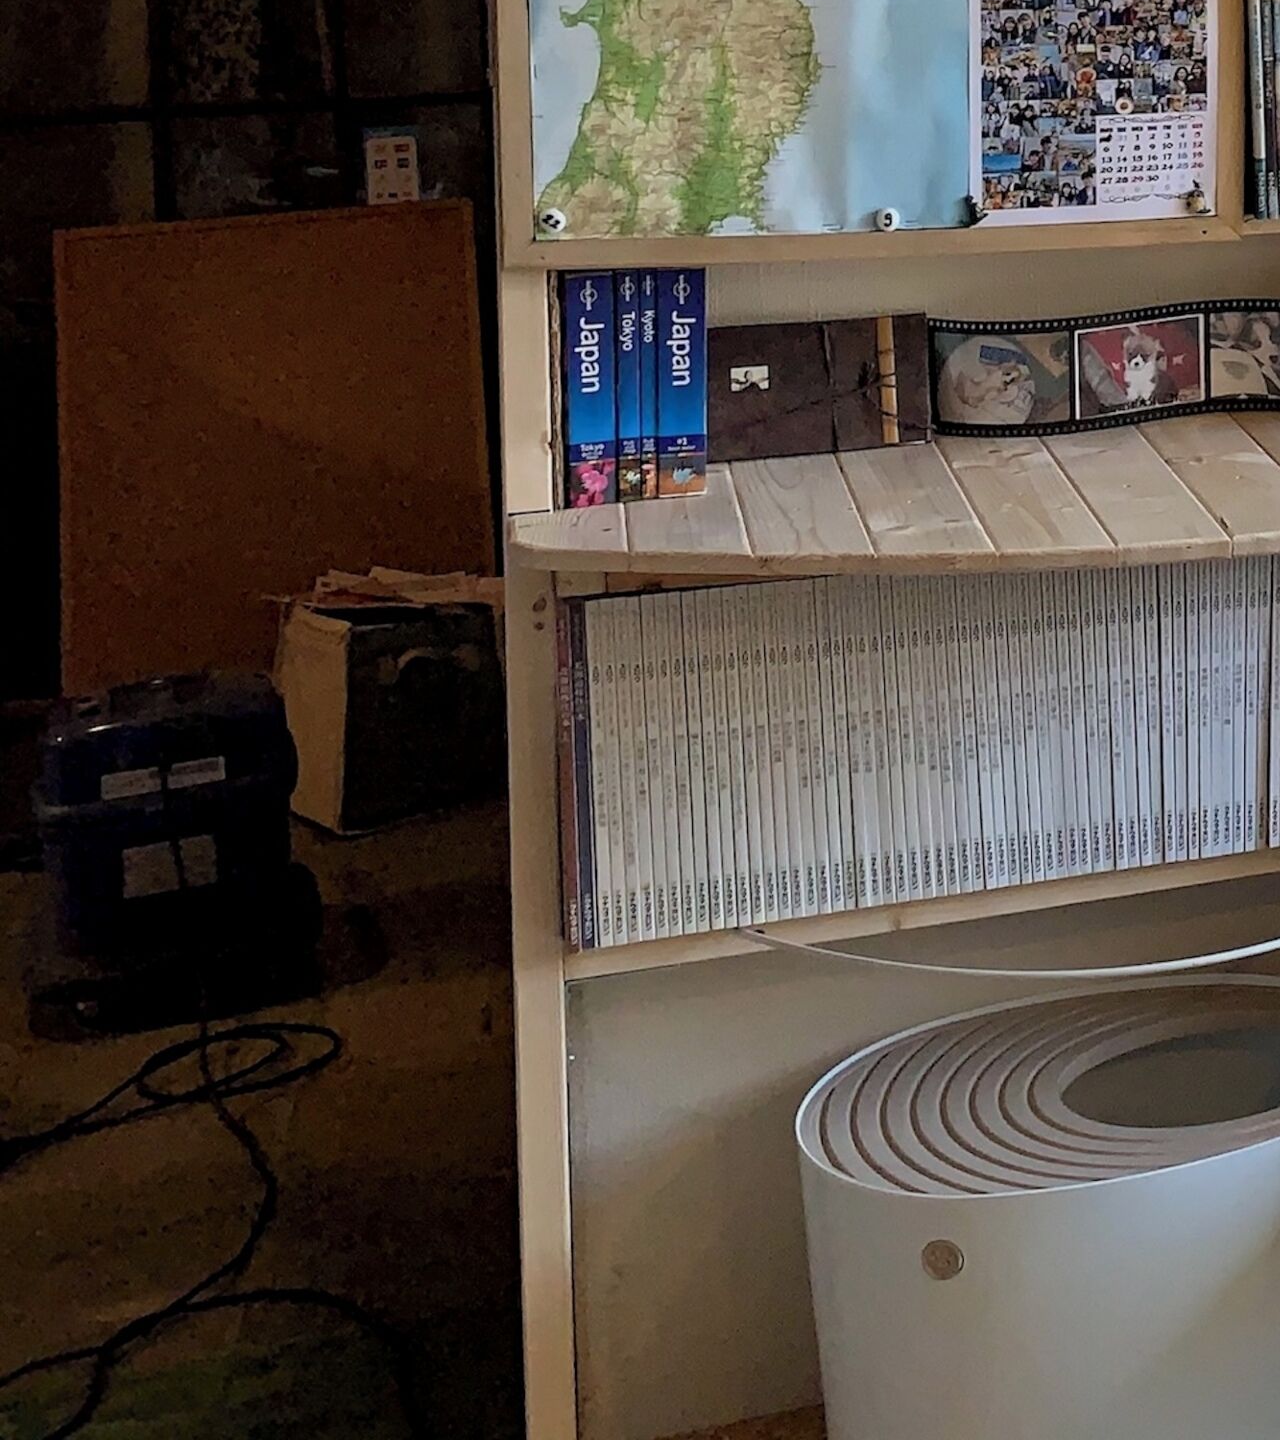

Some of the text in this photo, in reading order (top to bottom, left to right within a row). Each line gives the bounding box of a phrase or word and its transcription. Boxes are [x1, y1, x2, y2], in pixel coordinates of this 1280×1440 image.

[1162, 142, 1173, 150] 10
[621, 311, 636, 352] Tokyo
[641, 309, 656, 344] Kyoto
[574, 317, 605, 394] Japan
[666, 311, 697, 387] Japan
